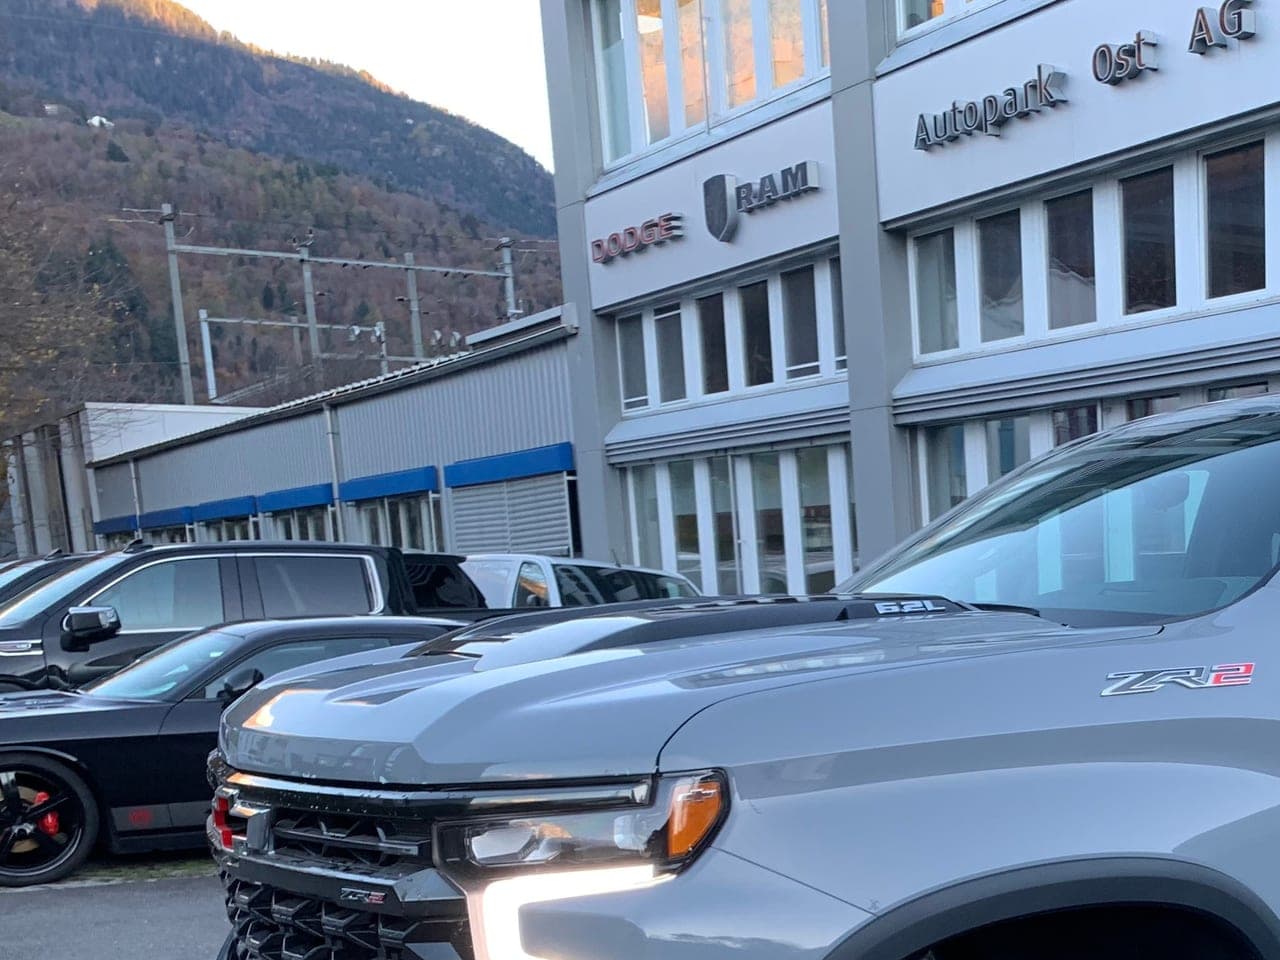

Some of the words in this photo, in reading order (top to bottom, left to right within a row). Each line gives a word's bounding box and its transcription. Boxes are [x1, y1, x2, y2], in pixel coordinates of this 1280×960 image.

[914, 64, 1068, 151] Autopark
[1091, 30, 1158, 86] Ost
[1189, 0, 1256, 55] AG
[735, 161, 819, 213] RAM
[591, 212, 683, 264] DODGE
[1101, 662, 1255, 697] ZR2
